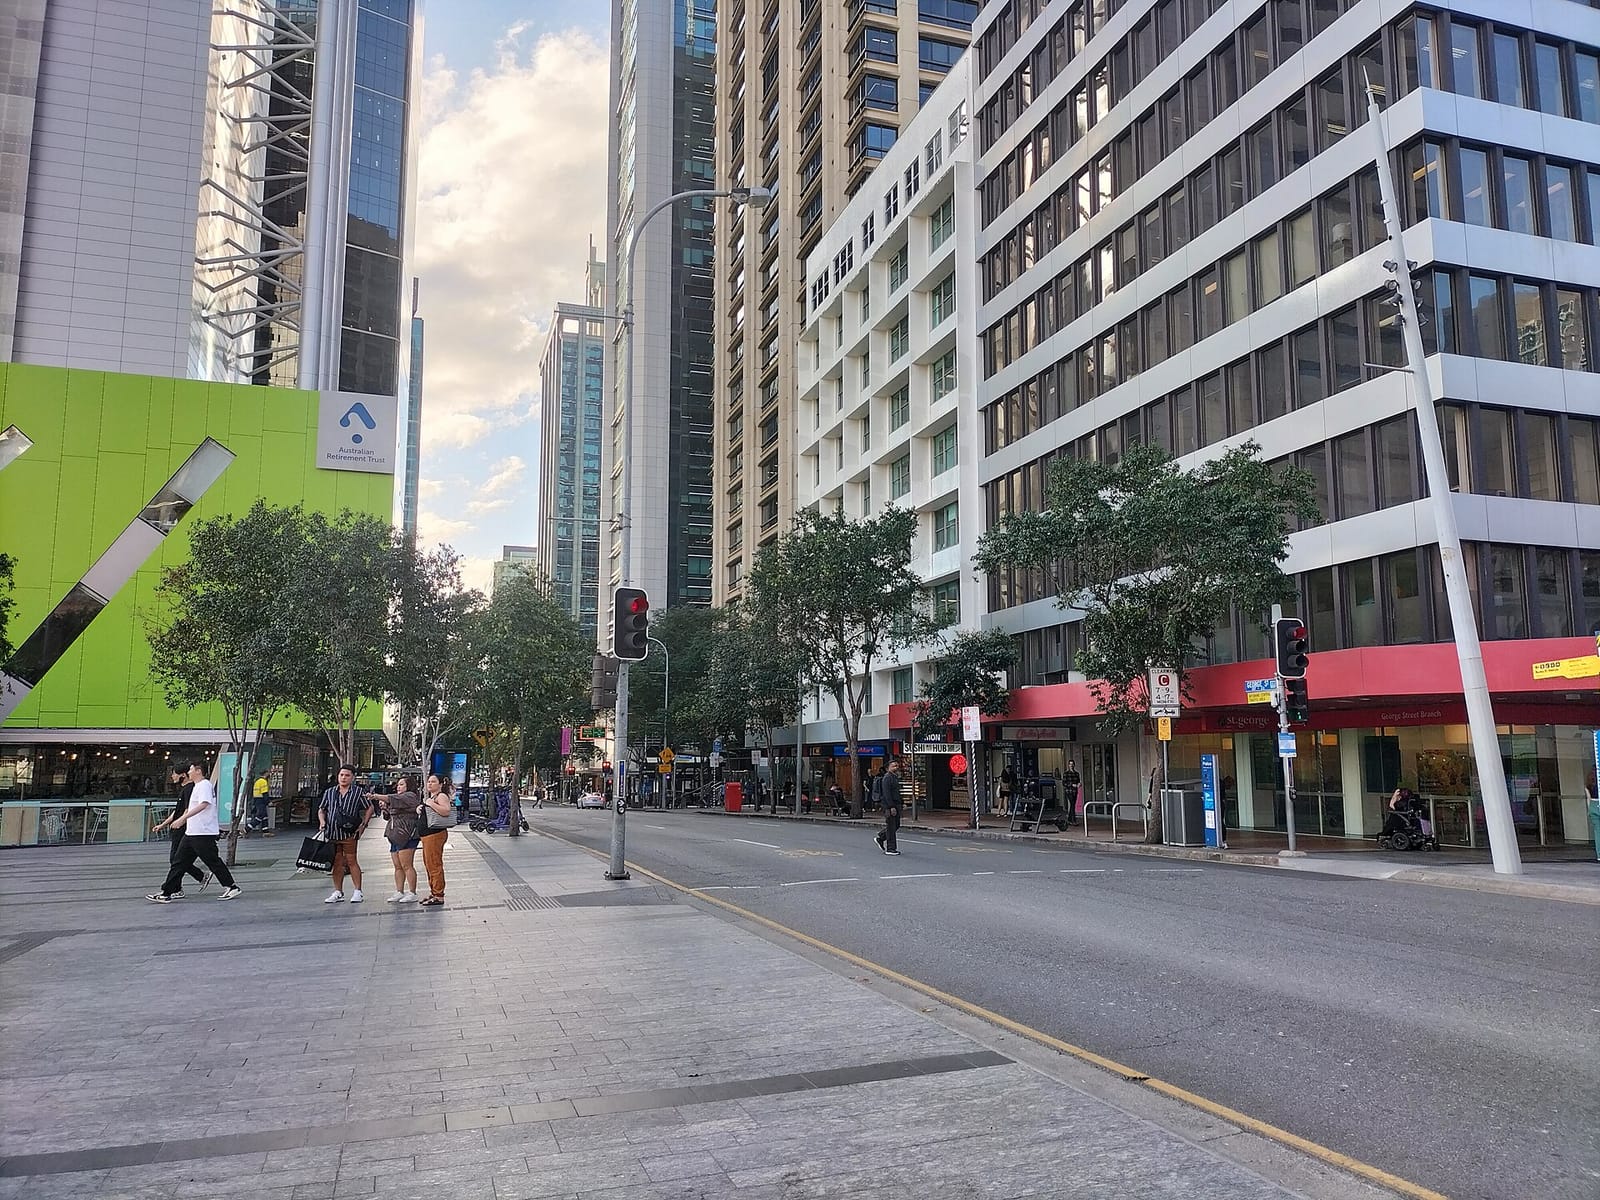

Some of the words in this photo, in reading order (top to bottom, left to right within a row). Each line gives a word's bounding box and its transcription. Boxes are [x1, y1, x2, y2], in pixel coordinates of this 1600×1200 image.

[338, 446, 375, 456] Australian
[326, 453, 366, 463] Retirement
[368, 455, 386, 464] Trust
[1381, 712, 1401, 721] George
[1402, 711, 1419, 719] Street
[1420, 710, 1442, 718] Branch
[1226, 715, 1269, 728] st.george
[932, 744, 947, 752] HUB
[298, 858, 326, 869] PLATYPUS
